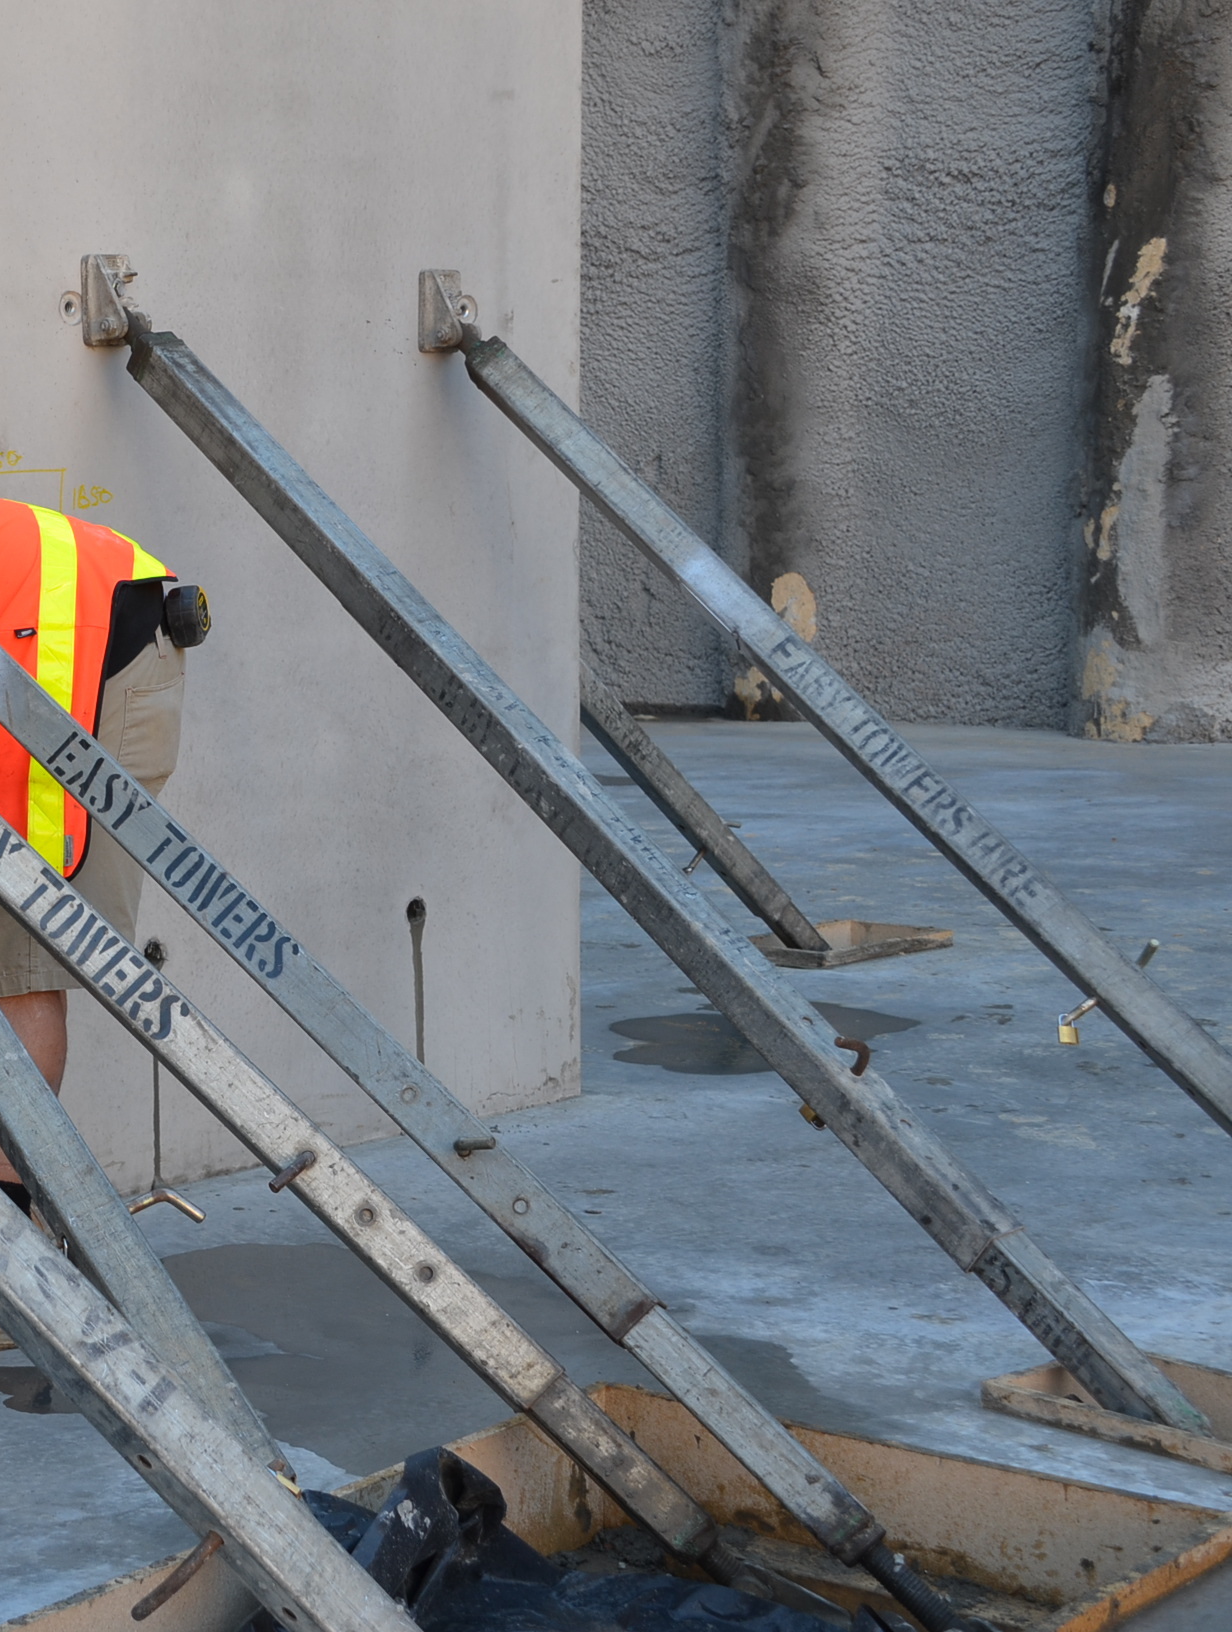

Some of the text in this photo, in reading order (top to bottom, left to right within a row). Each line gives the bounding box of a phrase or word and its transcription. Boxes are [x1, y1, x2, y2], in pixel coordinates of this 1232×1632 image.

[45, 730, 300, 980] EASY TOWERS
[847, 716, 976, 838] TOWERS
[20, 867, 191, 1041] TOWERS
